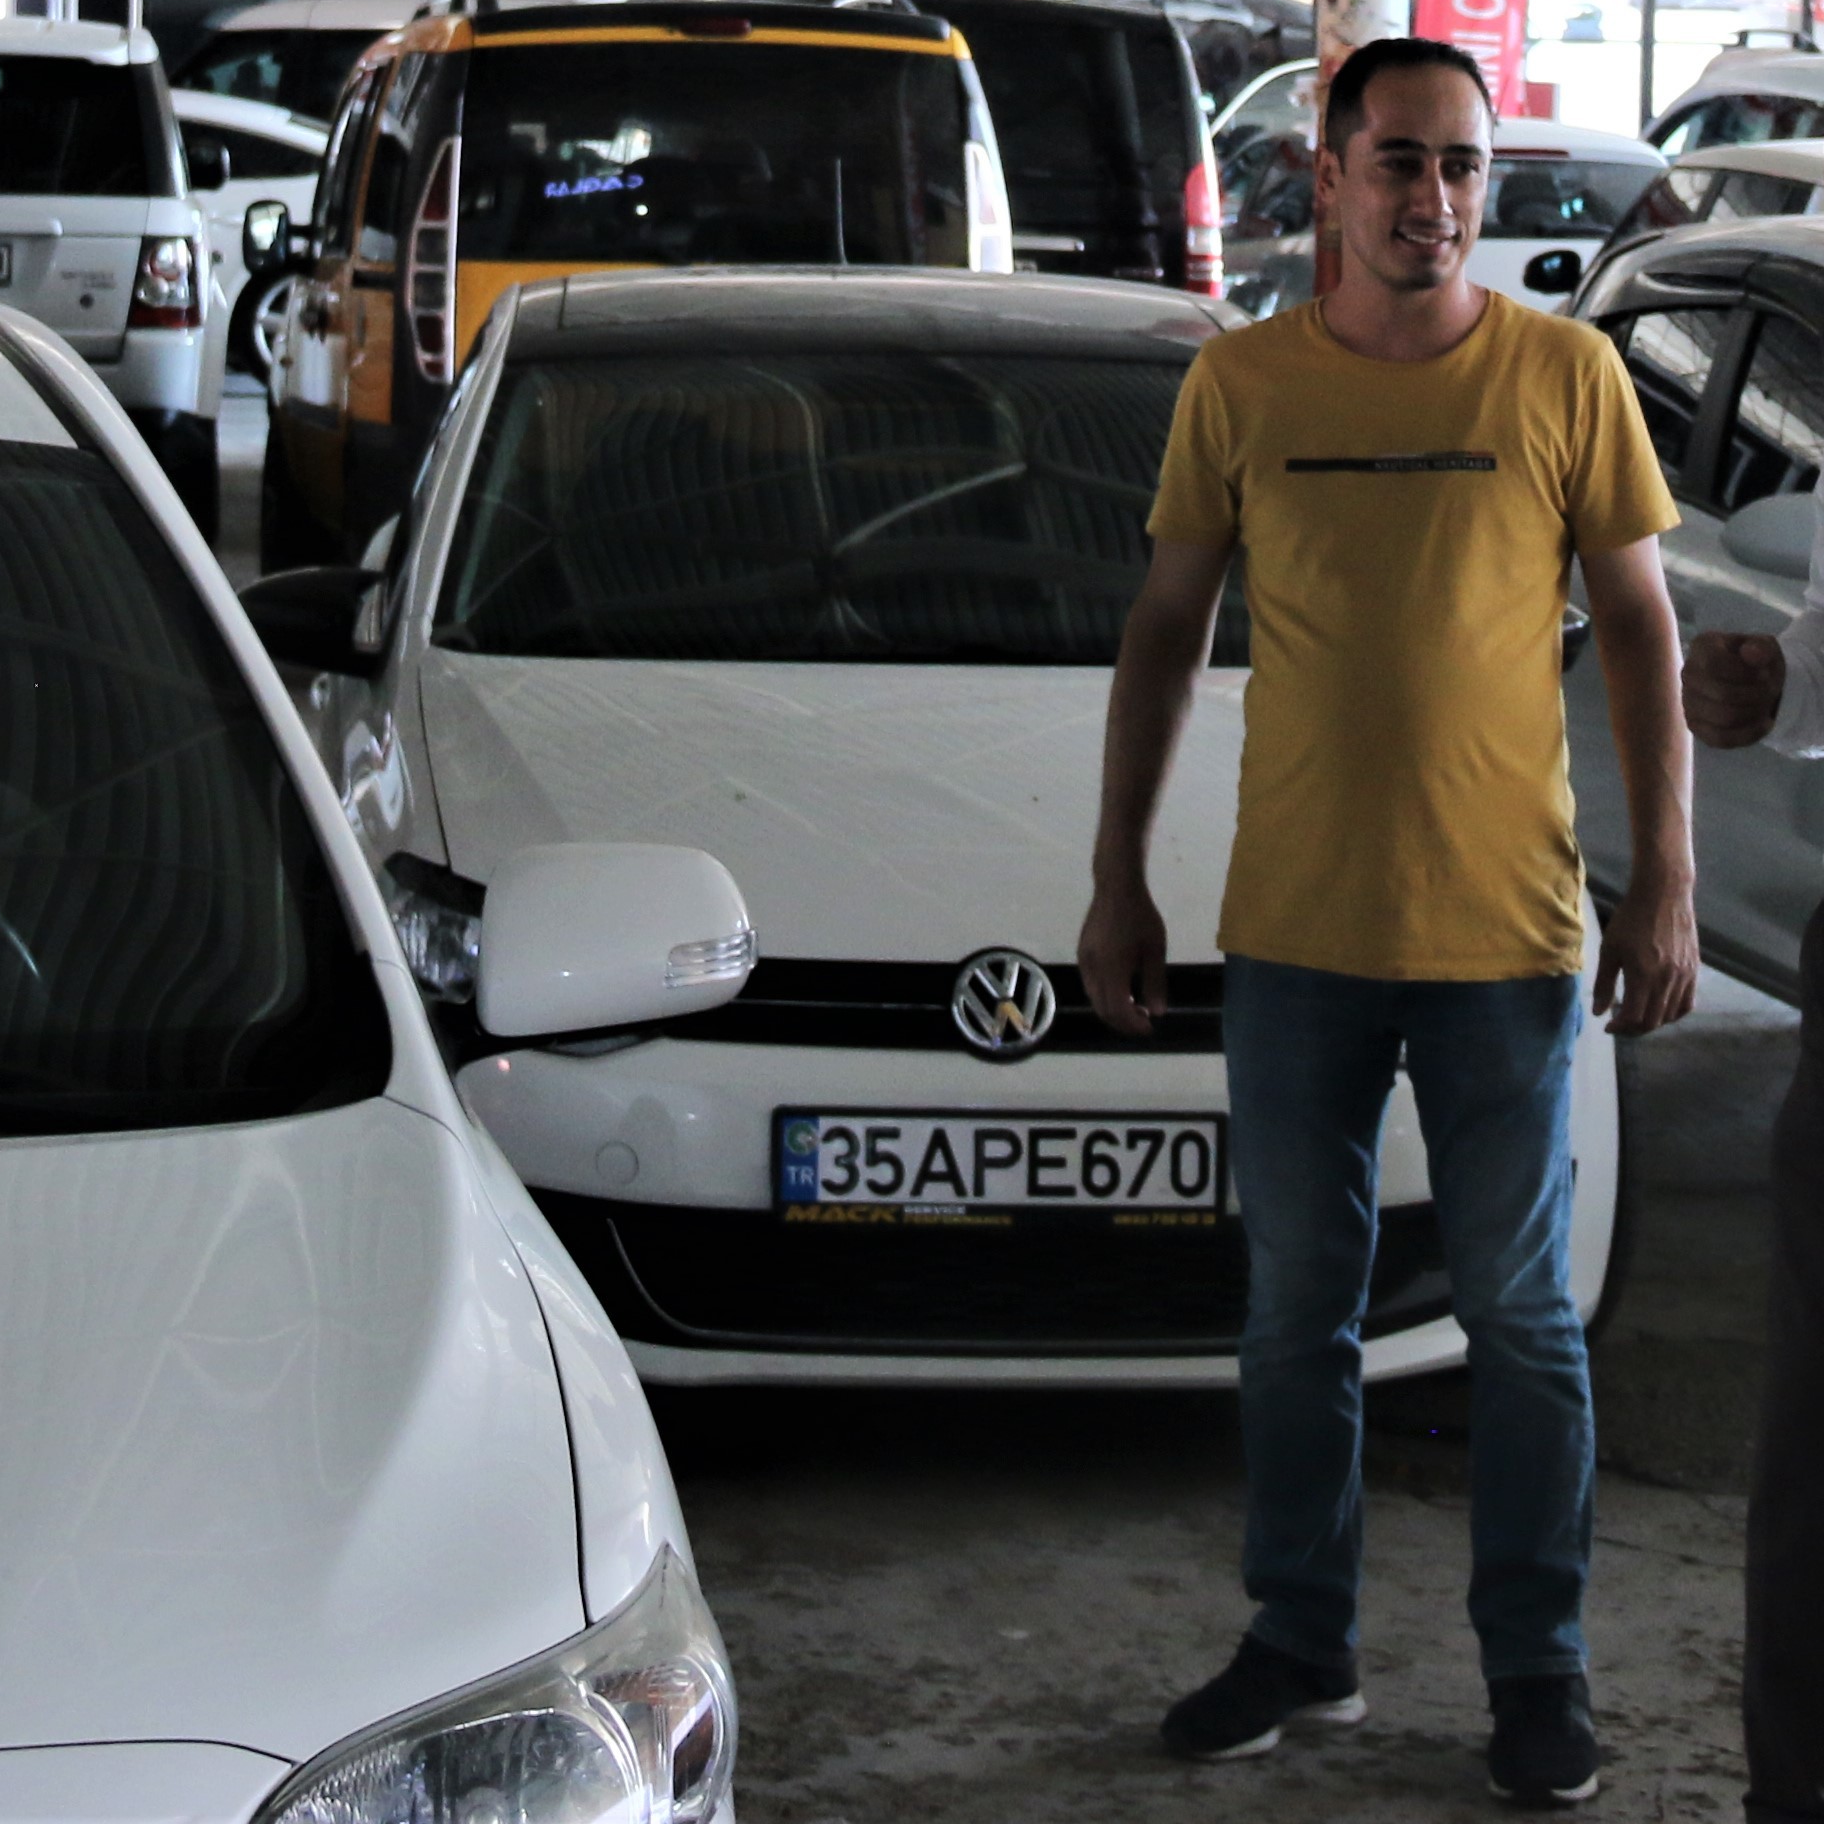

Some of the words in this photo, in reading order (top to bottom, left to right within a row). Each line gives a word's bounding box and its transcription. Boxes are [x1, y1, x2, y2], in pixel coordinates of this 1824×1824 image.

[787, 1166, 814, 1186] TR
[820, 1125, 1211, 1198] 35APE670
[784, 1203, 898, 1224] MACK
